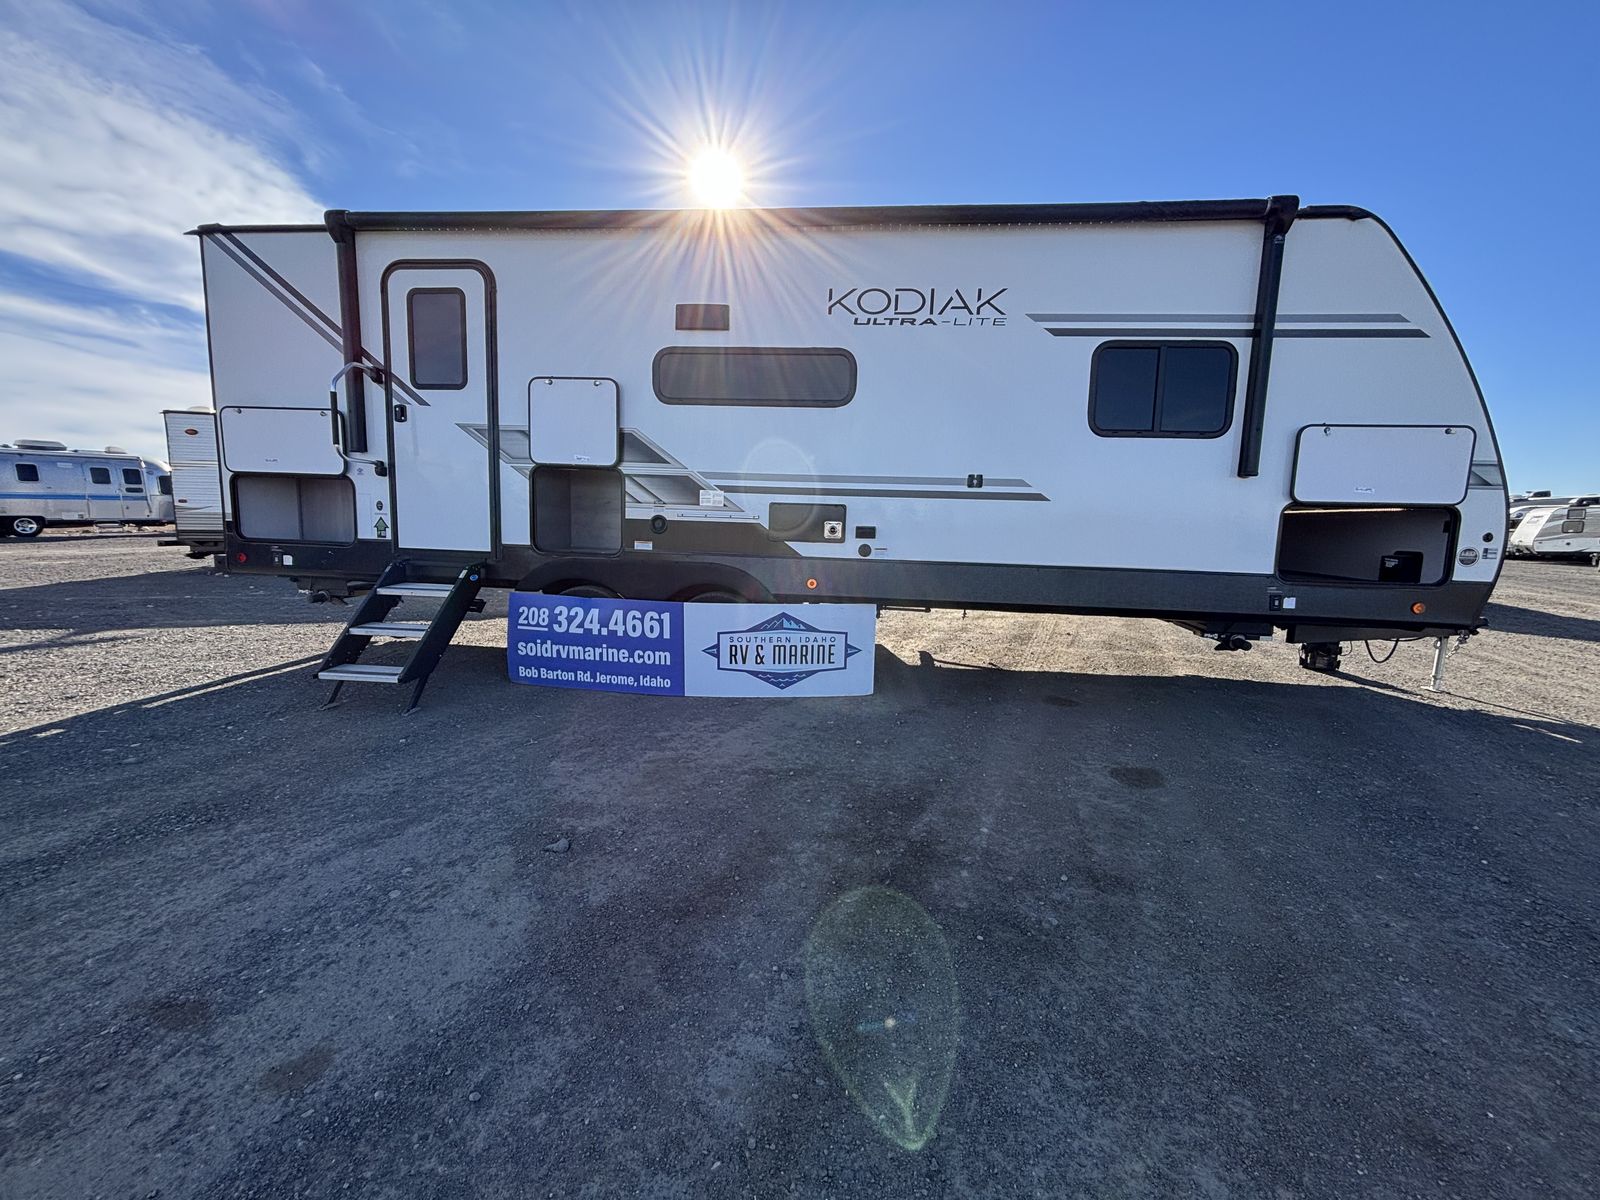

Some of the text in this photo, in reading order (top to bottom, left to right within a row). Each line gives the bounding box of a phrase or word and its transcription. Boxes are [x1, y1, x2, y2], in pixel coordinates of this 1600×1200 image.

[827, 288, 1009, 315] KODIAK
[853, 317, 1008, 326] ULTRA-LITE
[518, 605, 671, 639] 208 324.4661
[517, 639, 671, 666] soidrvmarine.com
[729, 644, 836, 665] RV & MARINE
[518, 666, 671, 688] Bob Barton Rd. Jerome, Idaho
